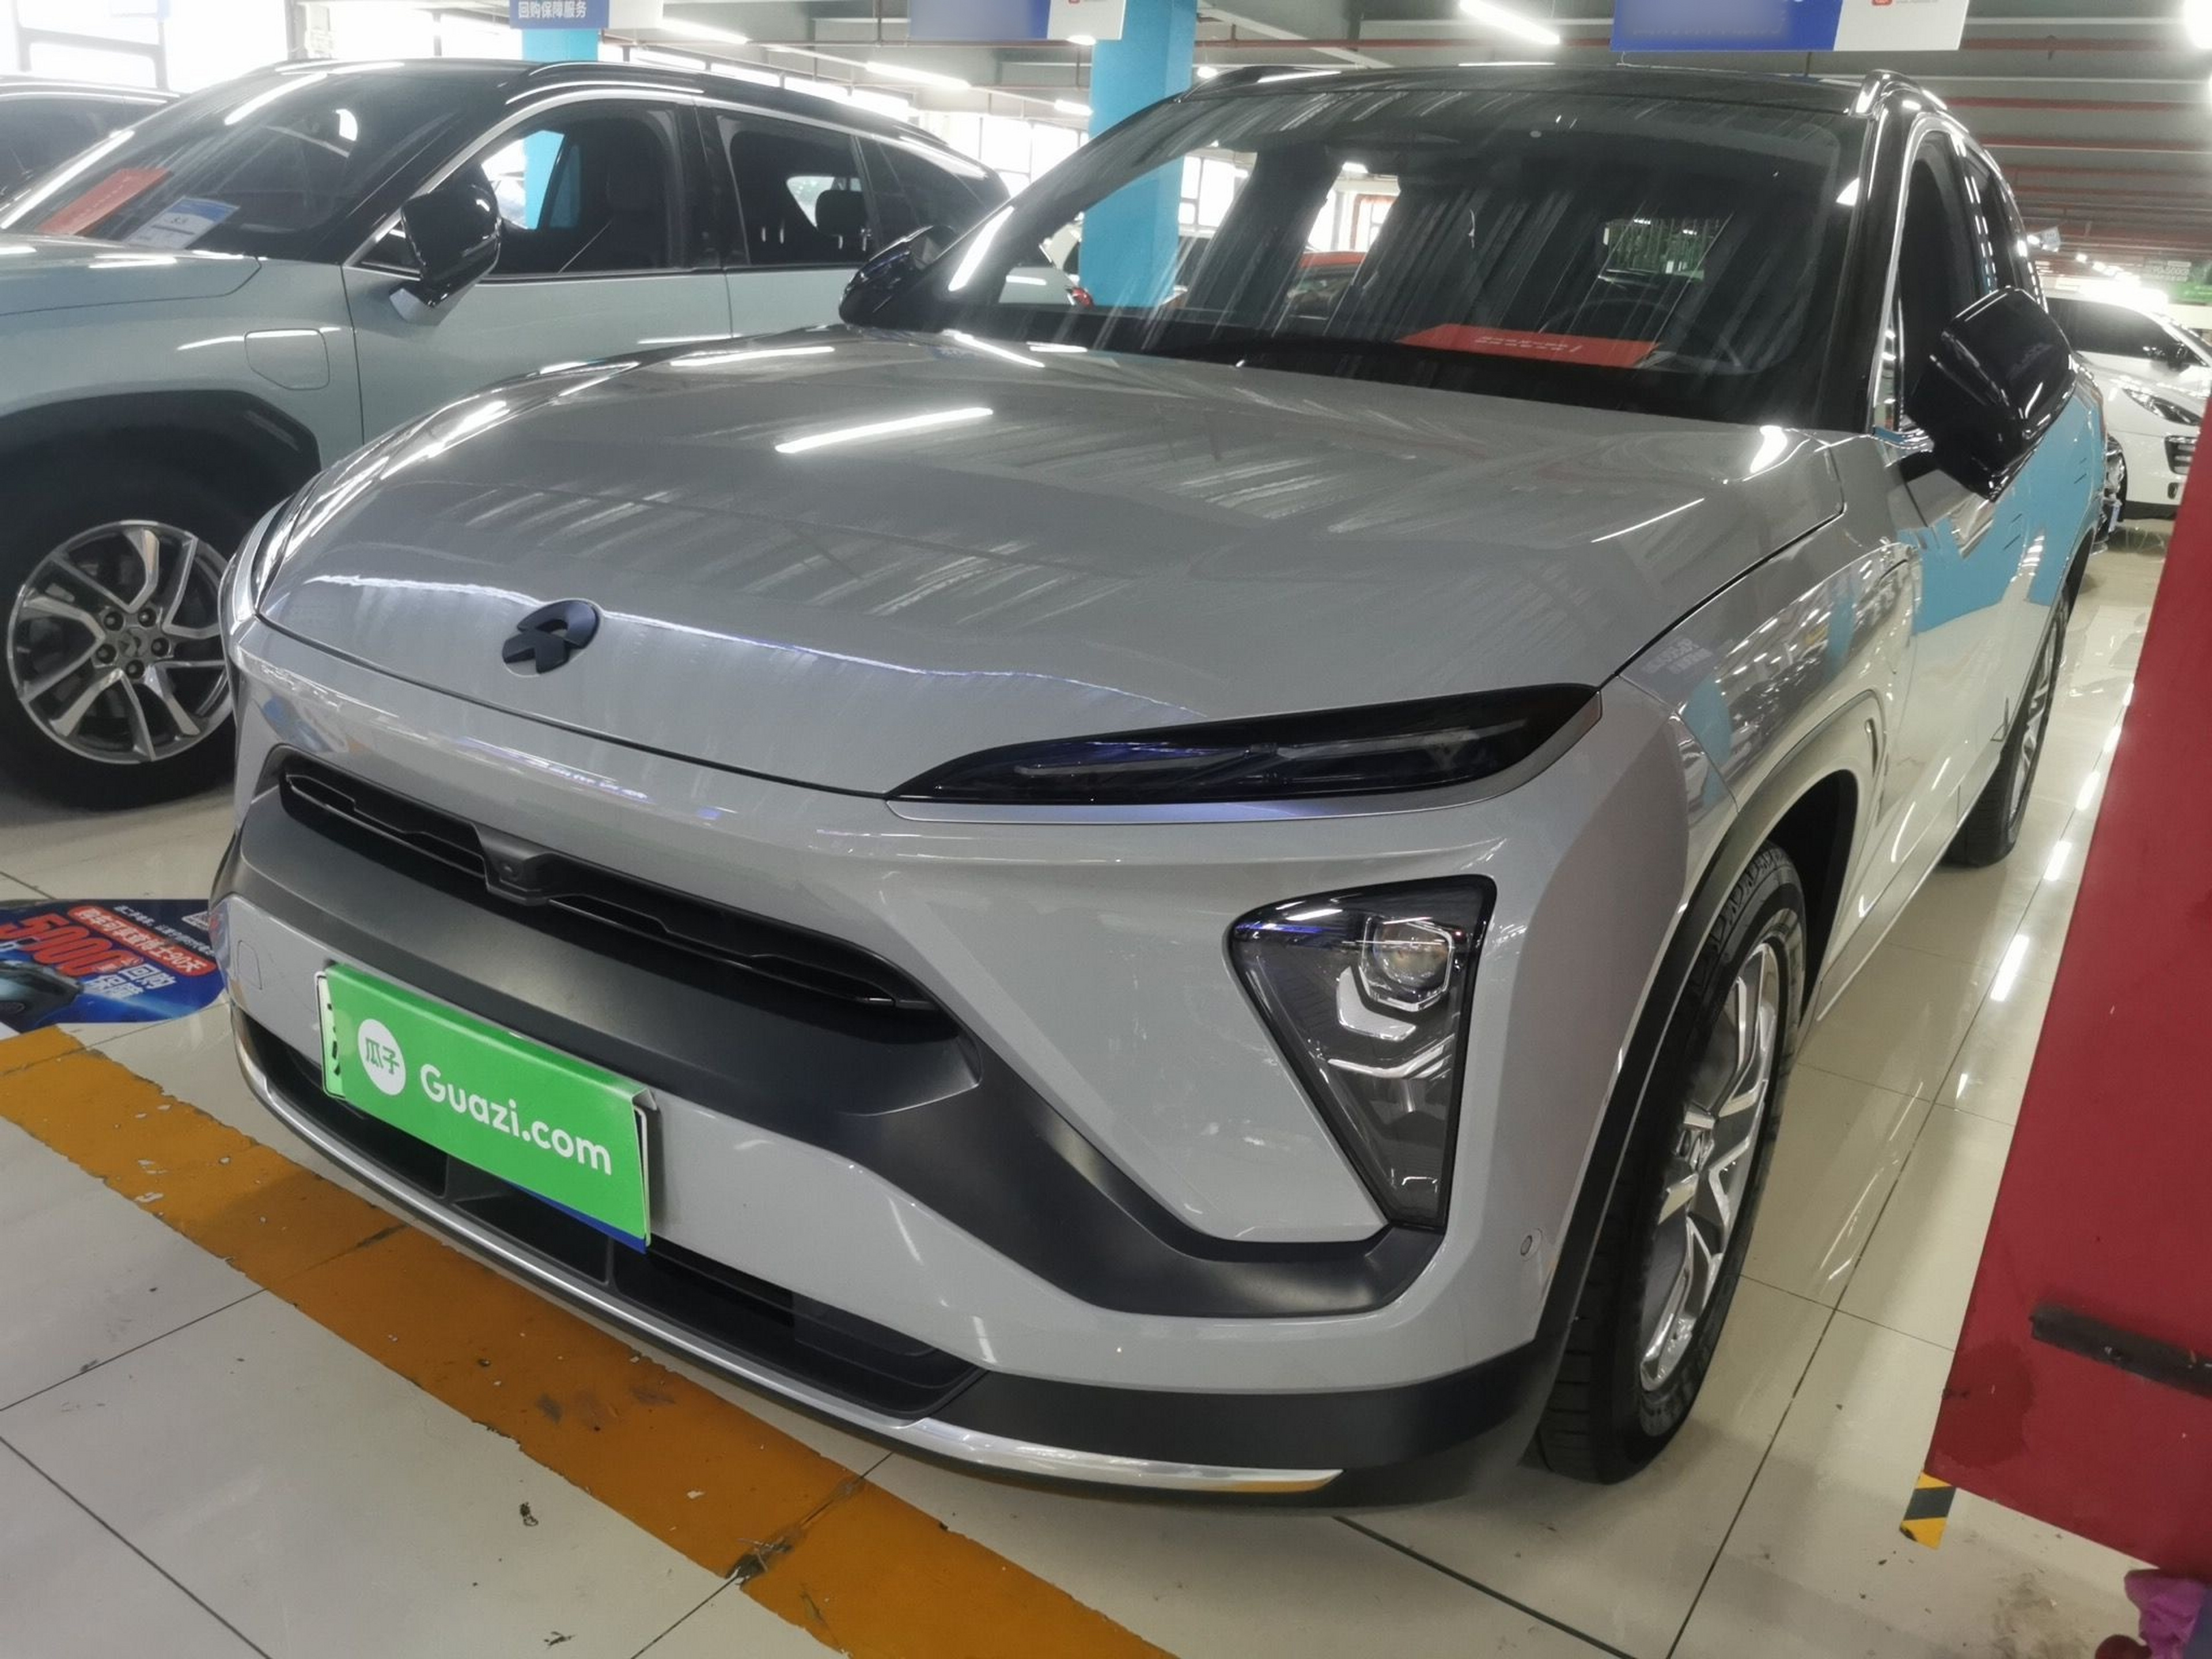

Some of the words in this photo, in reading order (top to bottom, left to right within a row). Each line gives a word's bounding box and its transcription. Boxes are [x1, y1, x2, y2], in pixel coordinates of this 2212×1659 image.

[518, 1, 587, 18] 回购保障服务
[365, 1039, 400, 1074] 瓜子
[421, 1064, 612, 1176] Guazi.com
